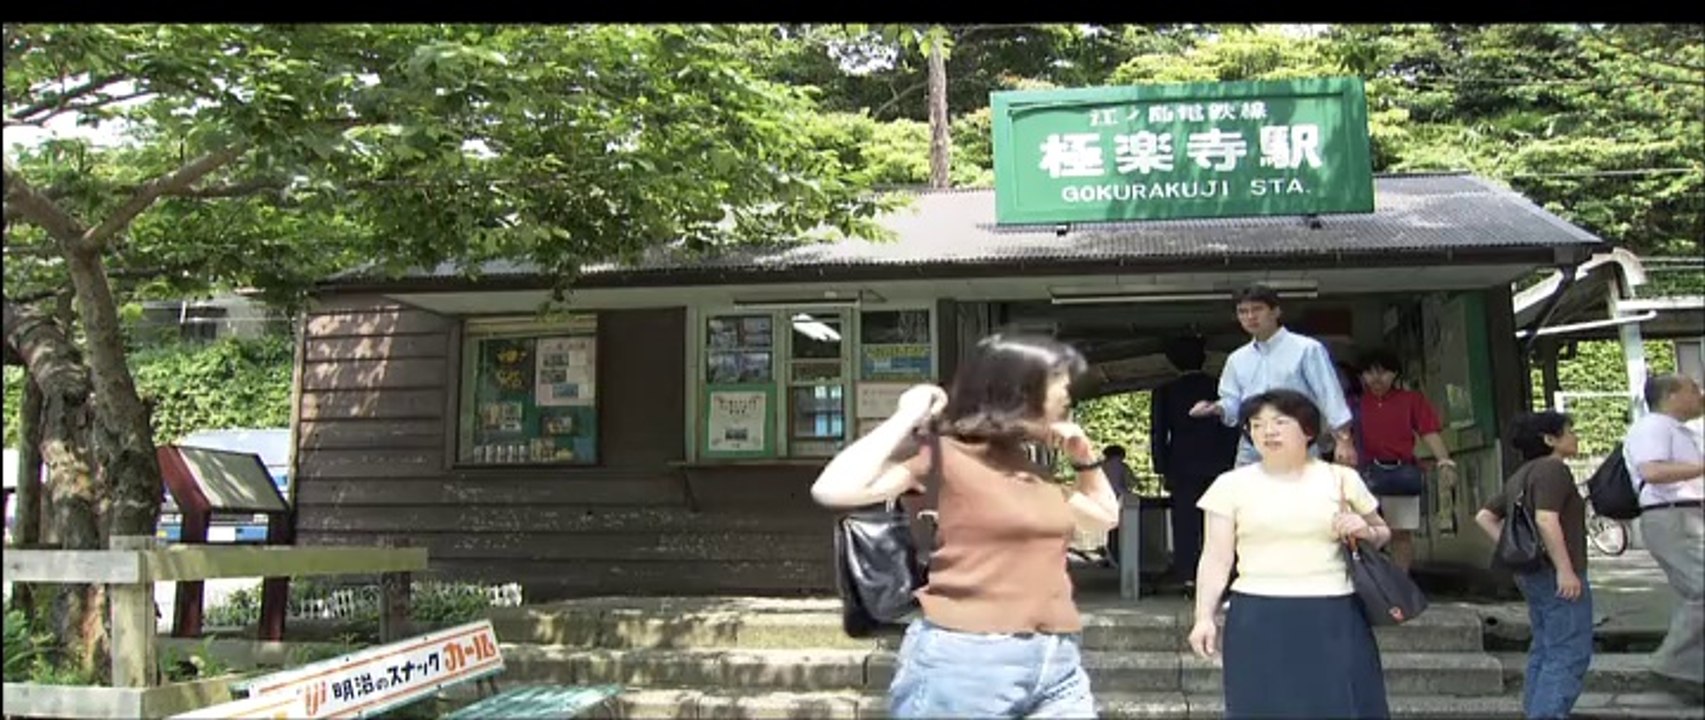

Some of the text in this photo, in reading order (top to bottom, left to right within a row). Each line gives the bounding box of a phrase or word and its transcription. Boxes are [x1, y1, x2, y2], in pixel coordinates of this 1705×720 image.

[1038, 123, 1323, 178] 極楽寺駅
[1061, 177, 1311, 202] GOKURAKUJI STA.
